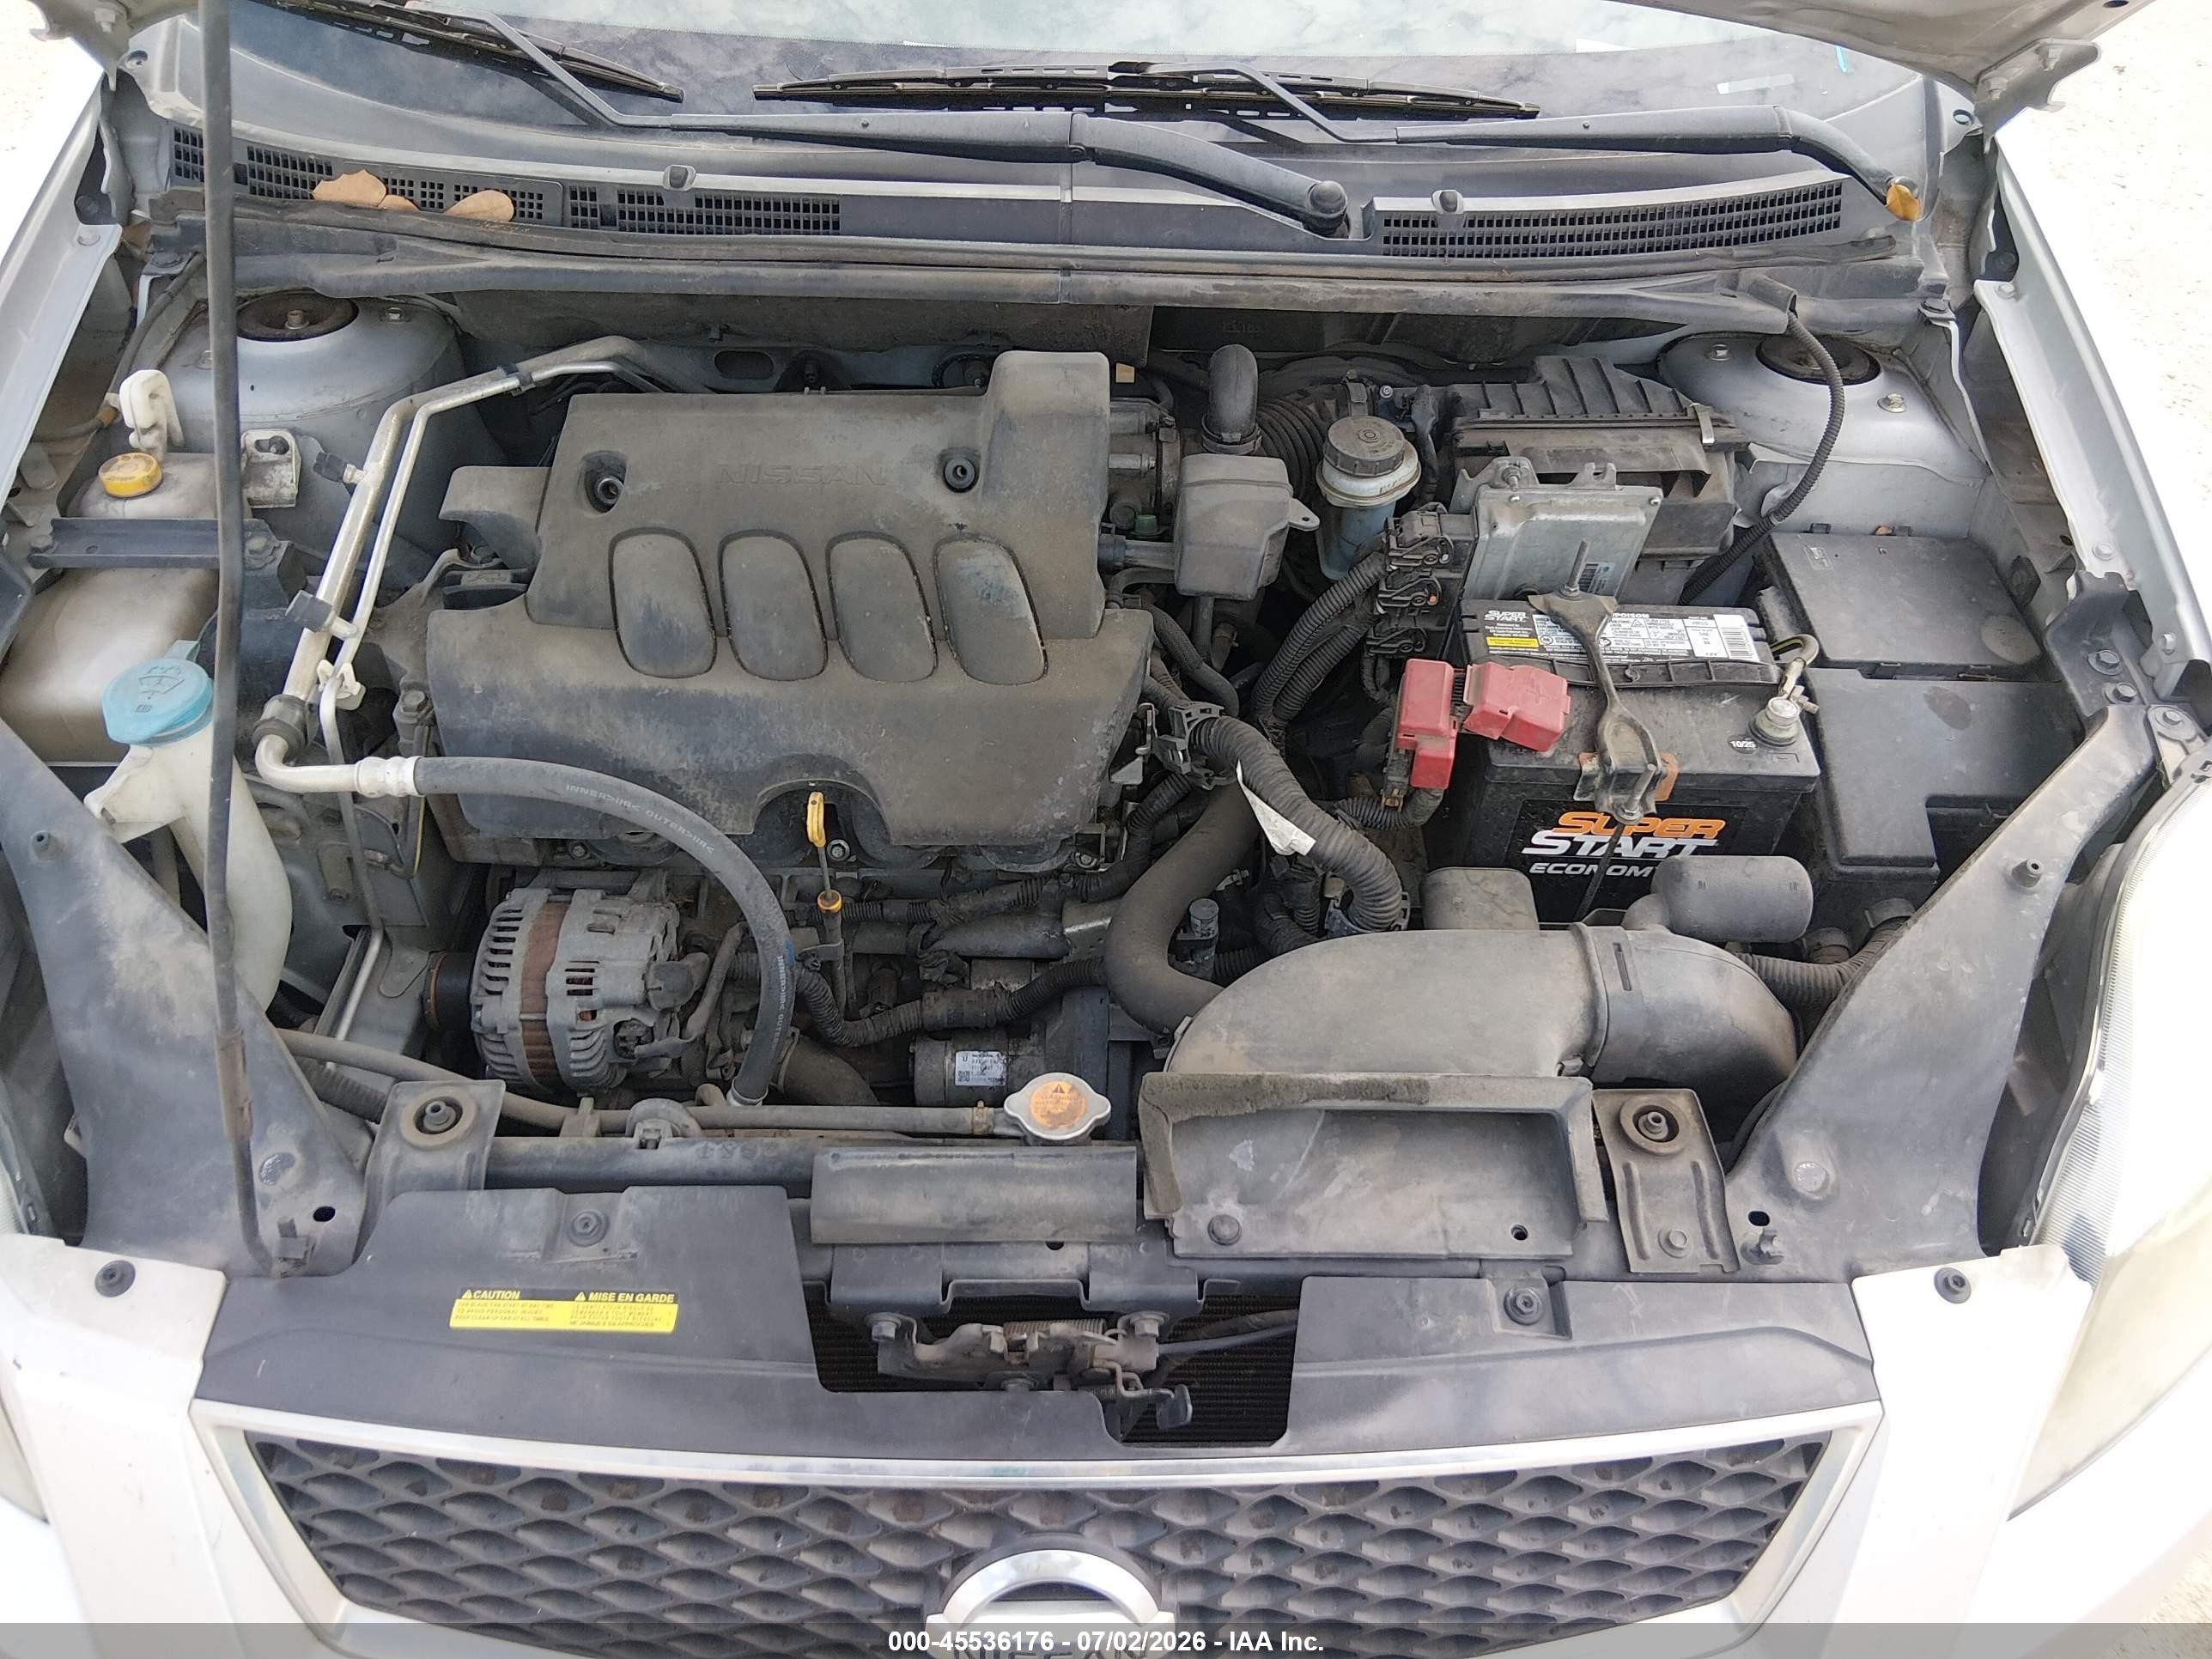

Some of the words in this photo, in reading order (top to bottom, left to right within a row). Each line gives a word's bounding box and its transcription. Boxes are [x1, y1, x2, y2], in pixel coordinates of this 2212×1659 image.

[714, 464, 891, 486] NISSAN
[1484, 613, 1529, 623] START
[1552, 811, 1726, 839] SUPER
[1522, 830, 1718, 859] START
[1529, 861, 1656, 878] ECONOM
[473, 1290, 521, 1300] CAUTION
[588, 1291, 617, 1302] MISE
[617, 1292, 634, 1303] EN
[635, 1293, 675, 1304] GARDE
